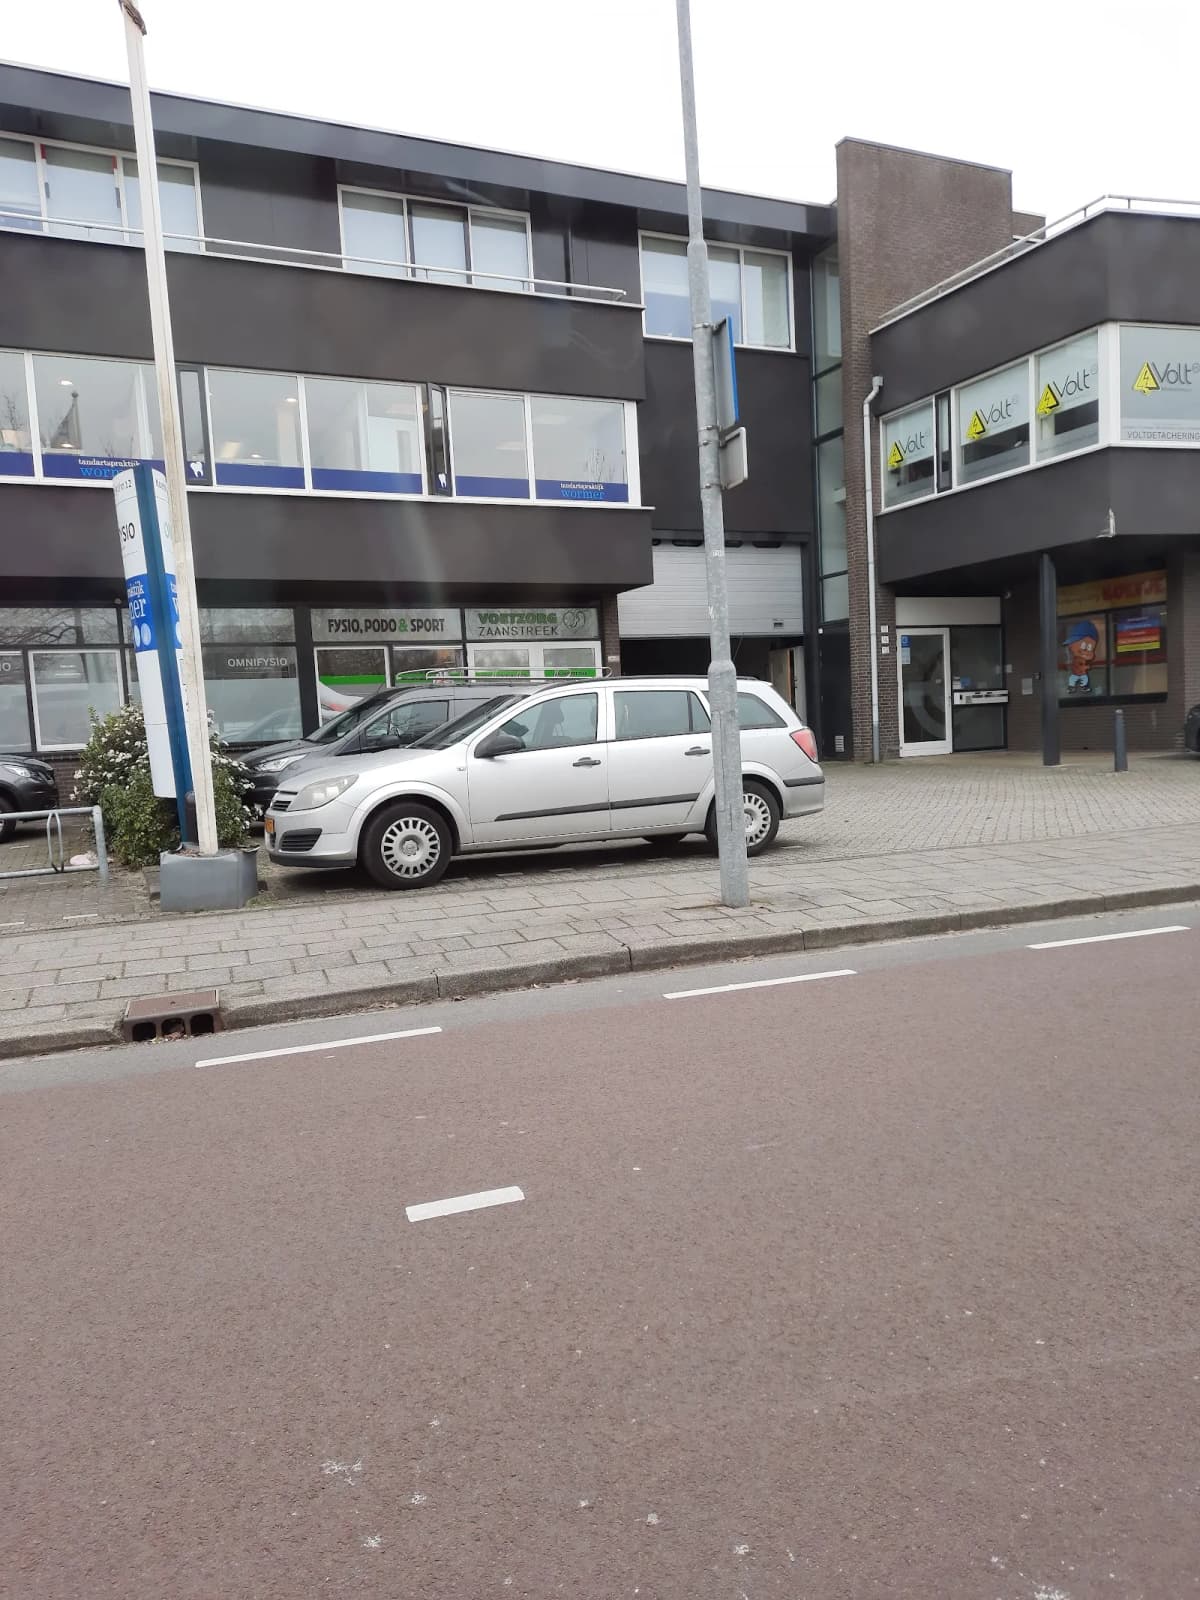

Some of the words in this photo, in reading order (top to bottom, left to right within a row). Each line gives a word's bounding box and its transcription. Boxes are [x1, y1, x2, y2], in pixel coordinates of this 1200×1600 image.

[1053, 368, 1090, 398] Volt
[1152, 360, 1192, 385] Volt
[980, 399, 1012, 425] Volt
[899, 431, 925, 454] Volt
[327, 618, 363, 633] FYSIO,
[364, 618, 397, 633] PODO
[398, 618, 409, 633] &
[410, 618, 445, 633] SPORT
[479, 625, 560, 637] ZAANSTREEK
[227, 656, 288, 668] OMNIFYSIO
